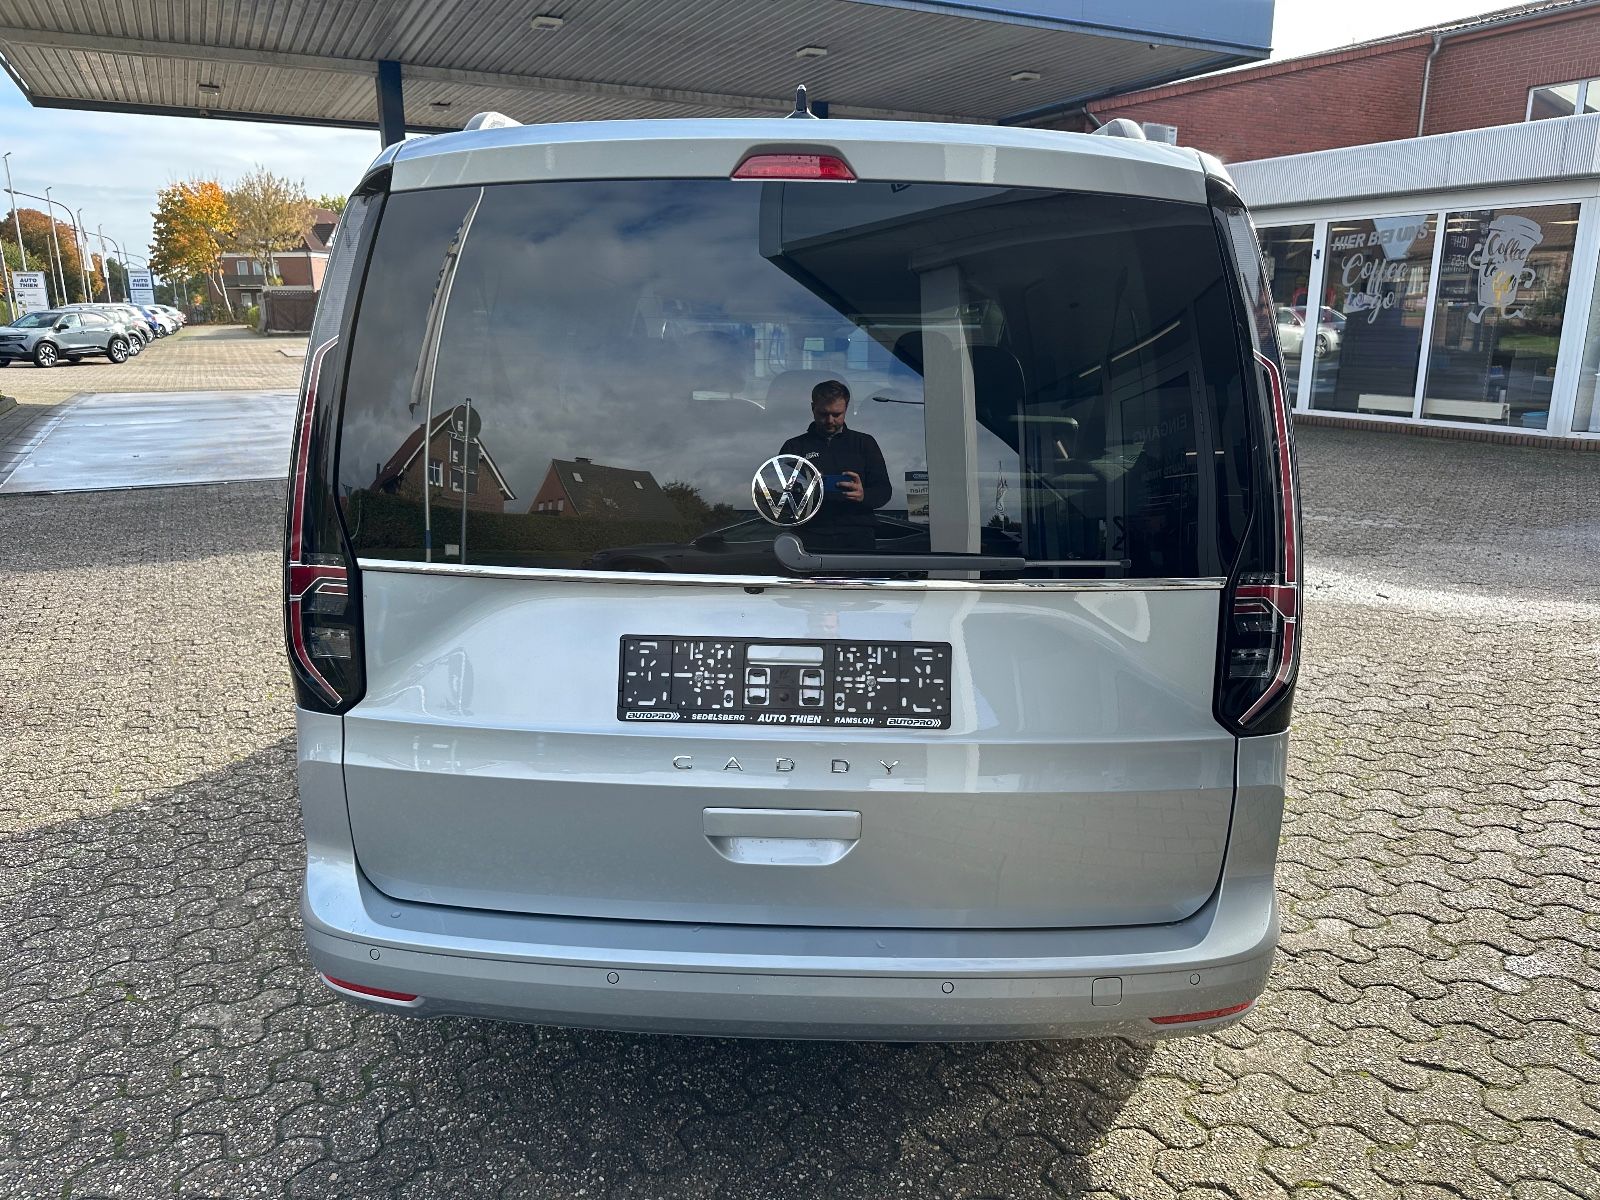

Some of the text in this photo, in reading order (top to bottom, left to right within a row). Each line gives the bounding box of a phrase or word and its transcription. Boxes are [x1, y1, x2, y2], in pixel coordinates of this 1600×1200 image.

[1331, 222, 1430, 251] HIER BEI UNS
[1488, 233, 1526, 262] Coffee
[1341, 253, 1408, 295] Coffee
[1344, 287, 1396, 324] to go
[691, 713, 746, 721] SEDELSBERG
[757, 714, 787, 723] AUTO
[789, 714, 822, 724] THIEN
[834, 716, 875, 725] RAMSLOH
[672, 755, 899, 775] CADDY
